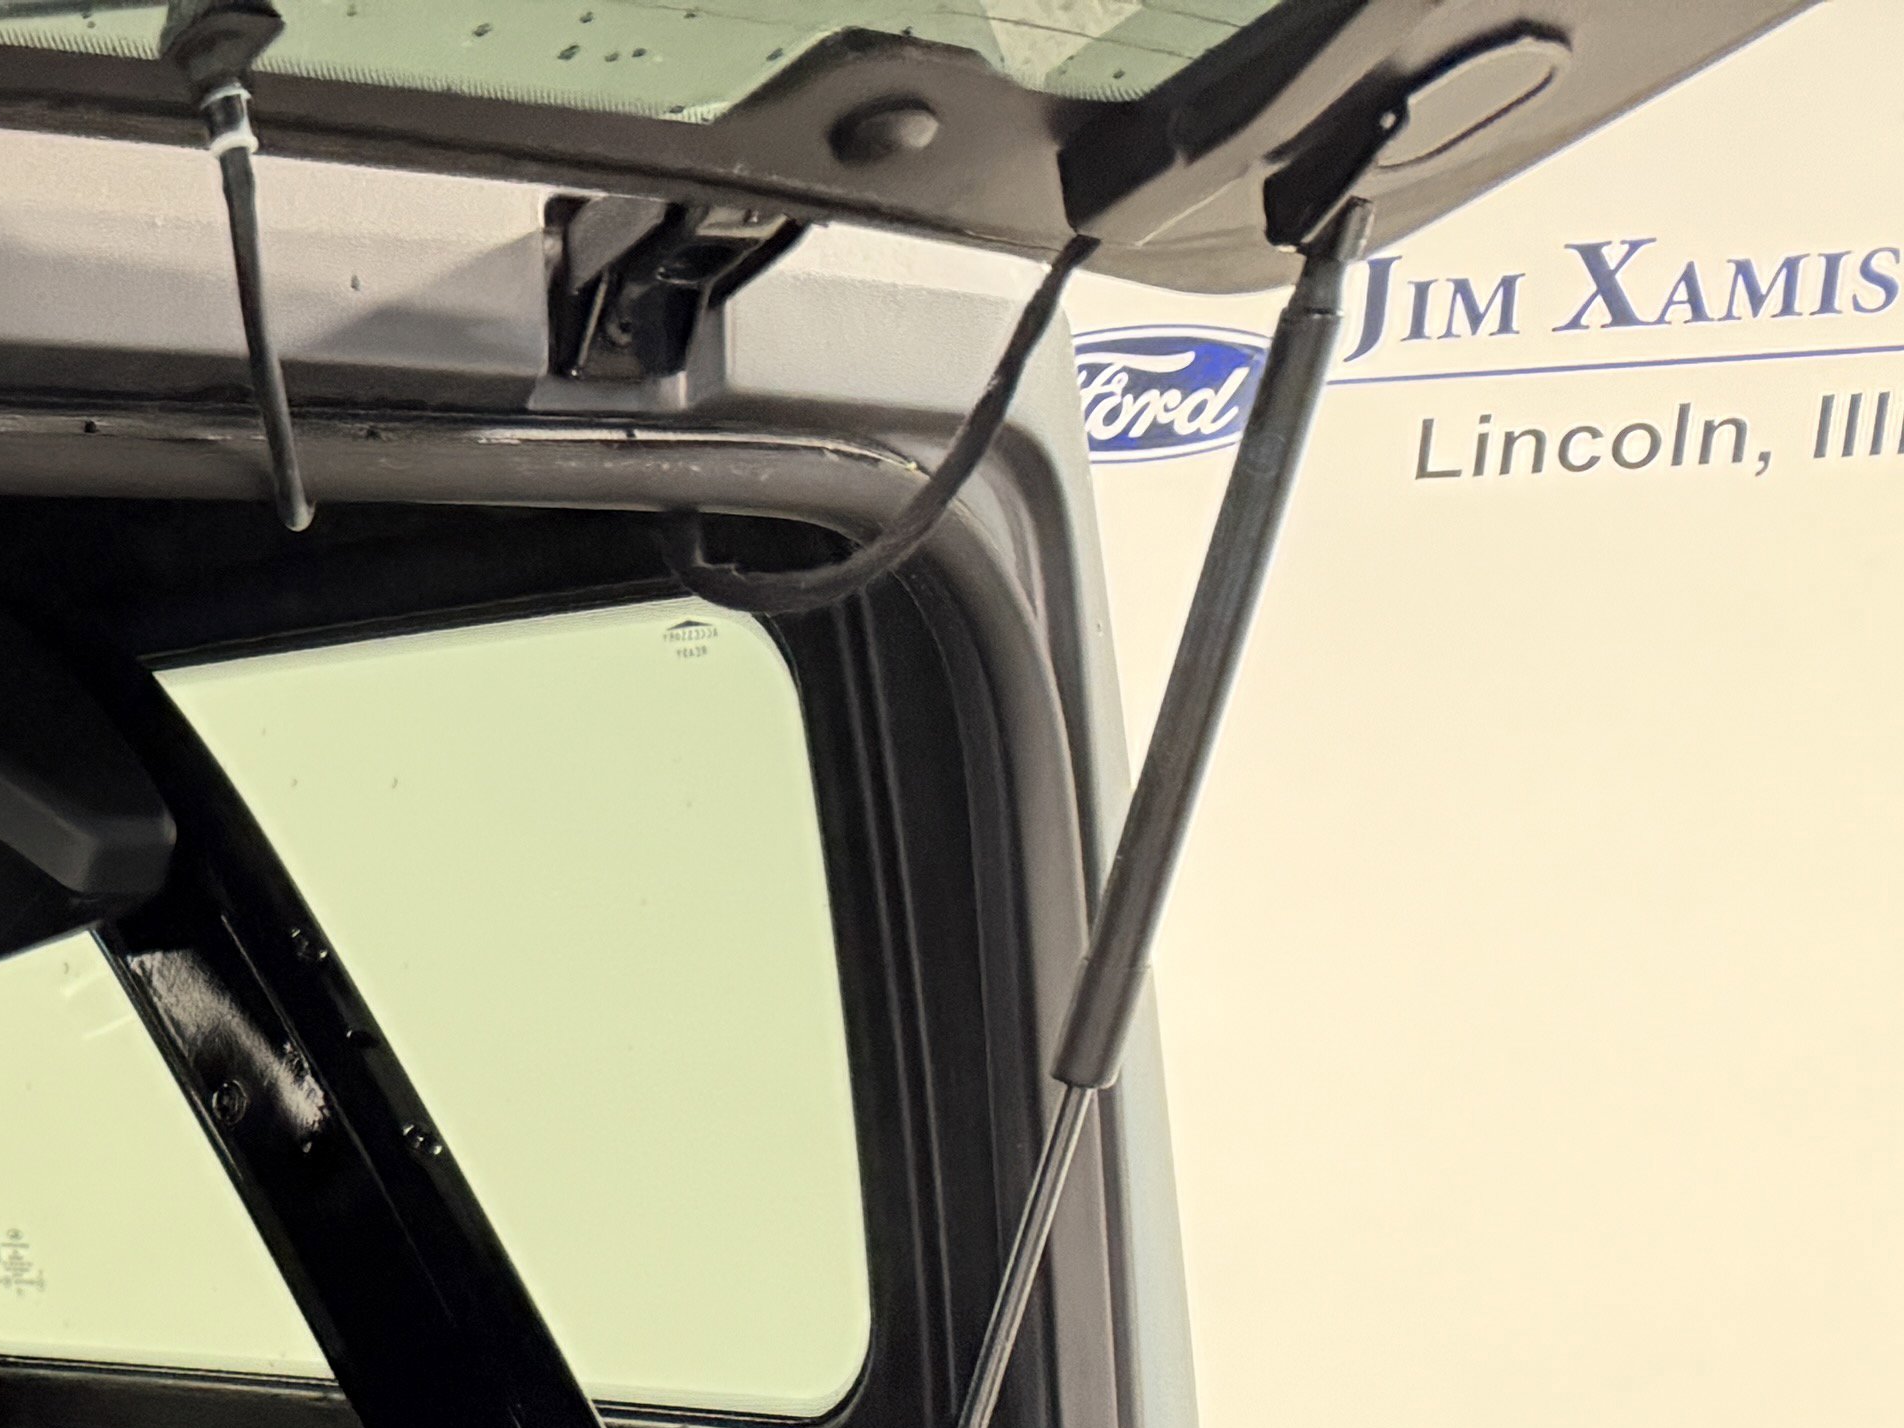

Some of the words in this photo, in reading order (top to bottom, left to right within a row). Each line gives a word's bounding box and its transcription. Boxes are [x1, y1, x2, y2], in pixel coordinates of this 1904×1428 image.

[1343, 255, 1526, 363] JIM
[1552, 237, 1901, 332] XAMIS
[1076, 351, 1251, 441] Ford
[1415, 401, 1771, 477] Lincoln,
[1813, 391, 1904, 459] Ill
